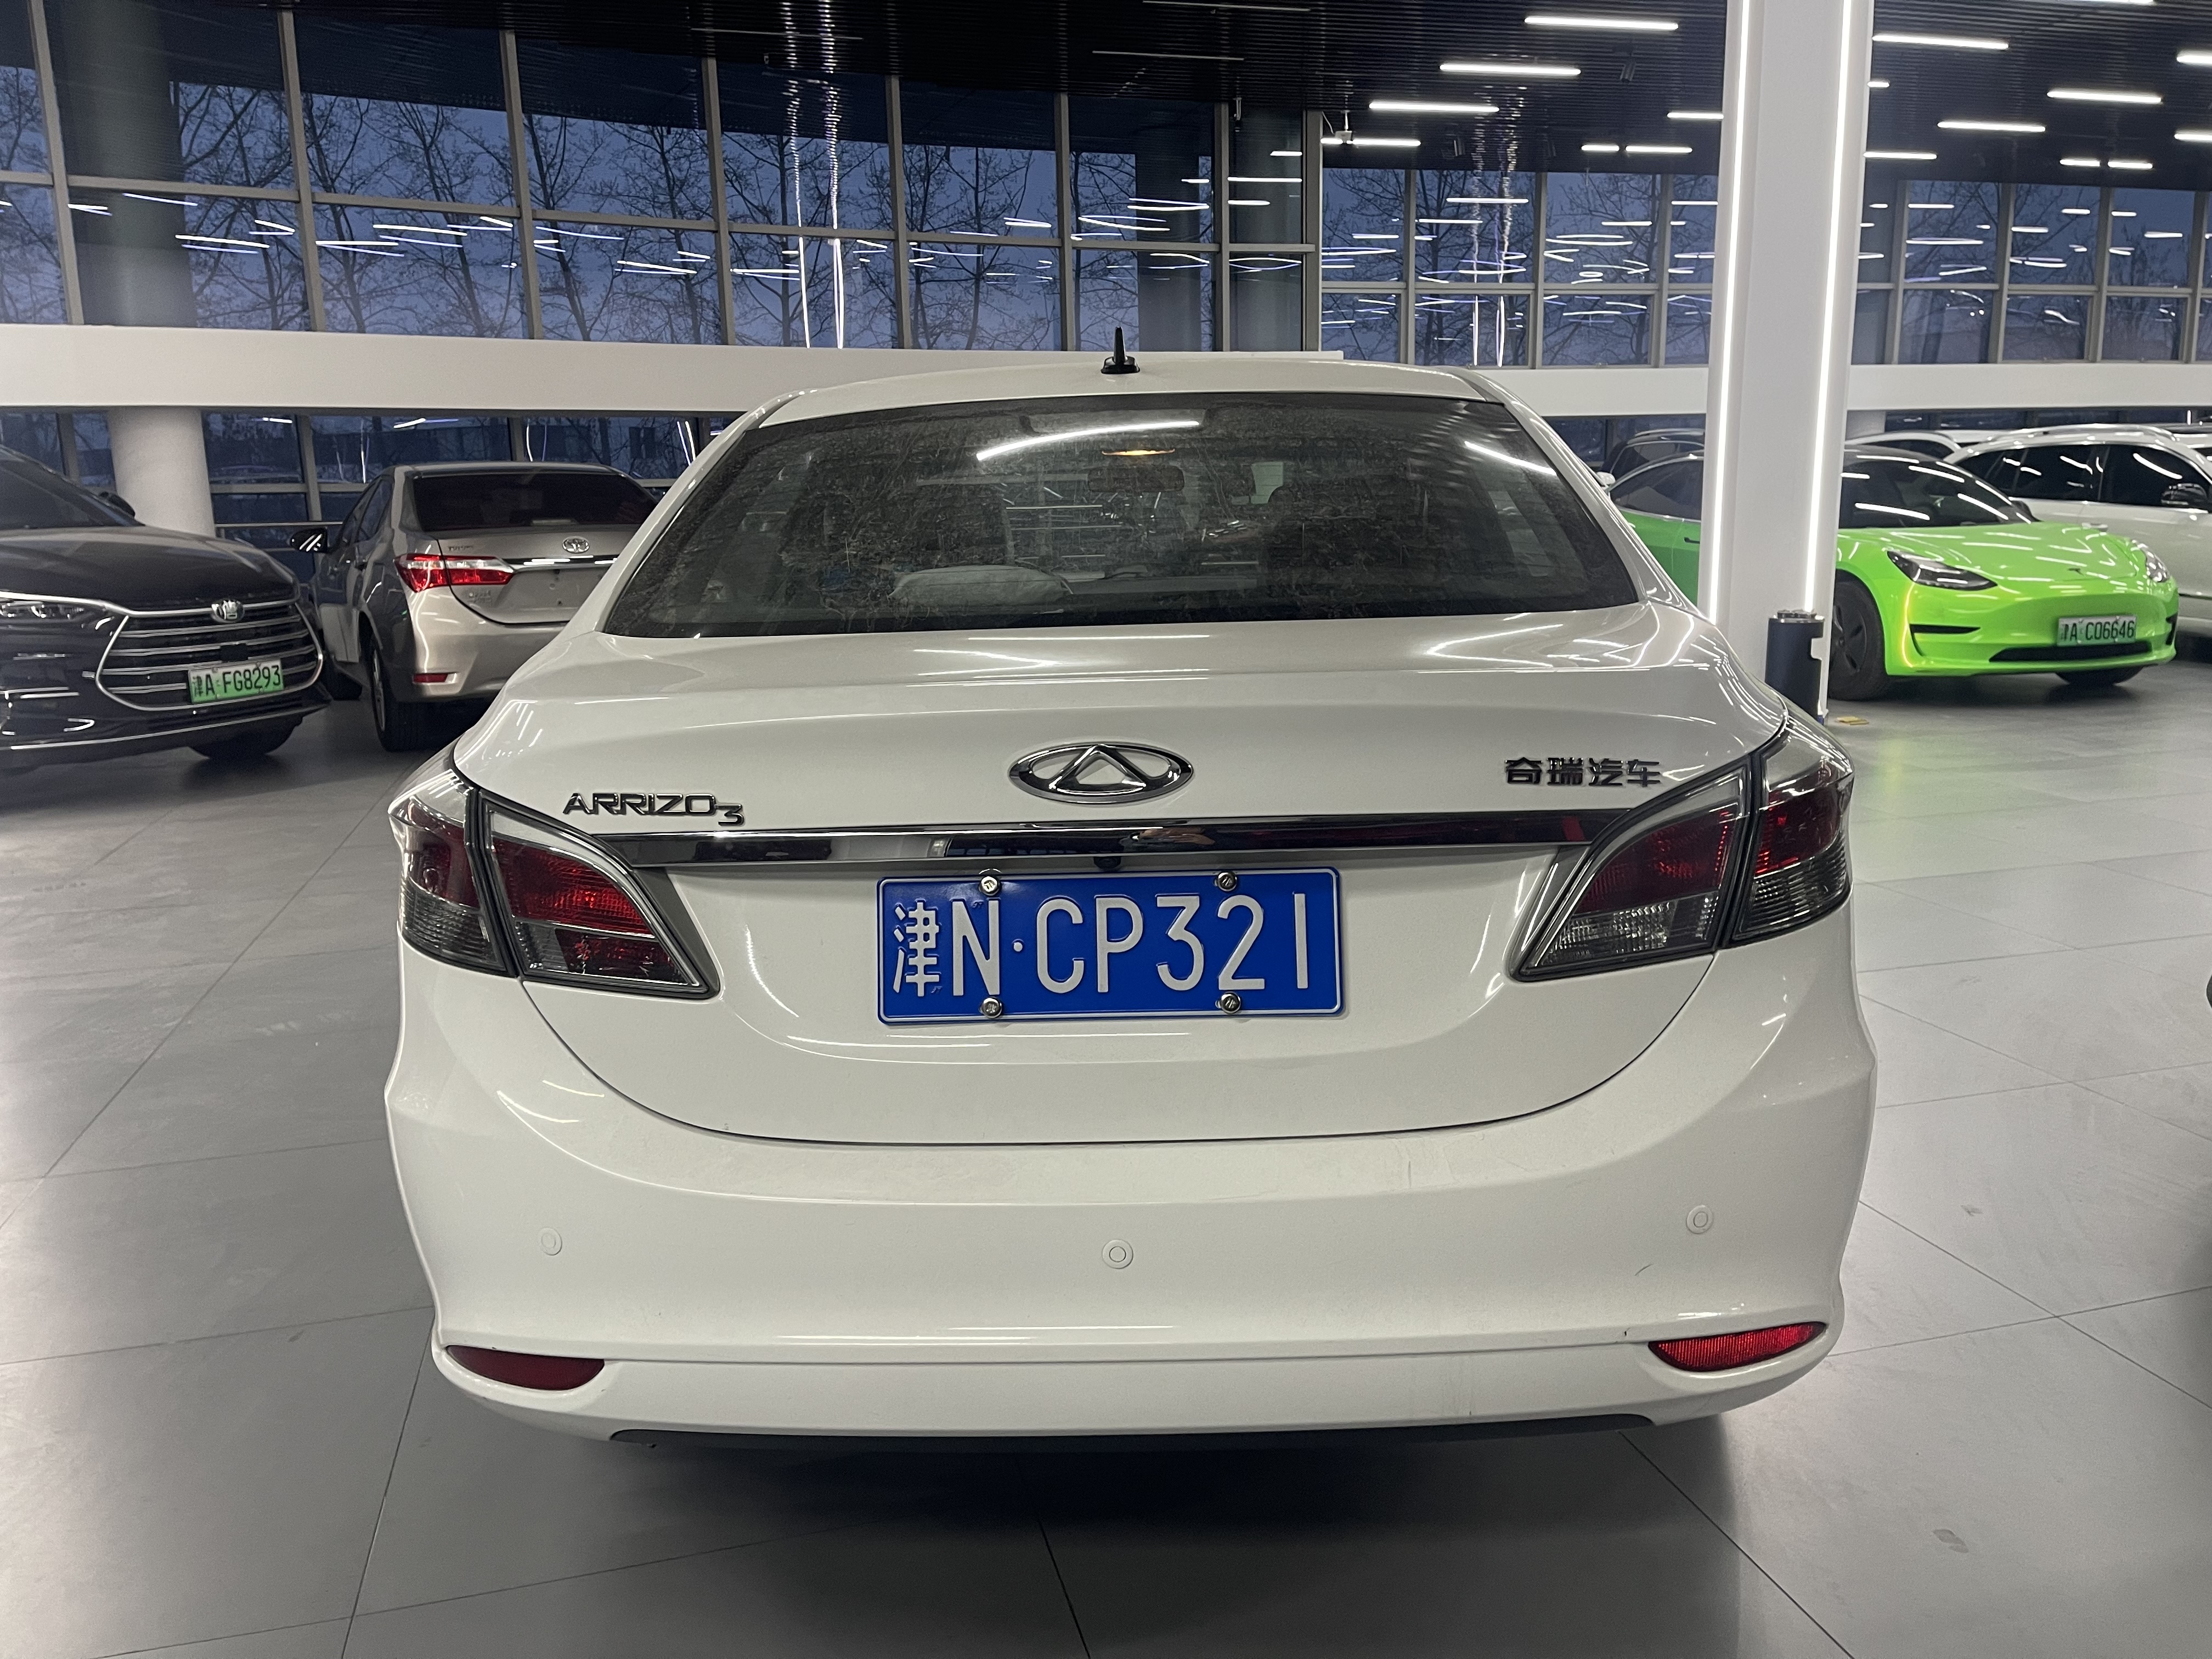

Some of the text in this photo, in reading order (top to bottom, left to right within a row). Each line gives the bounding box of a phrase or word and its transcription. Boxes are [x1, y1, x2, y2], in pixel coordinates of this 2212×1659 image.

[222, 665, 281, 693] FG8293
[1505, 757, 1661, 787] 奇瑞汽车
